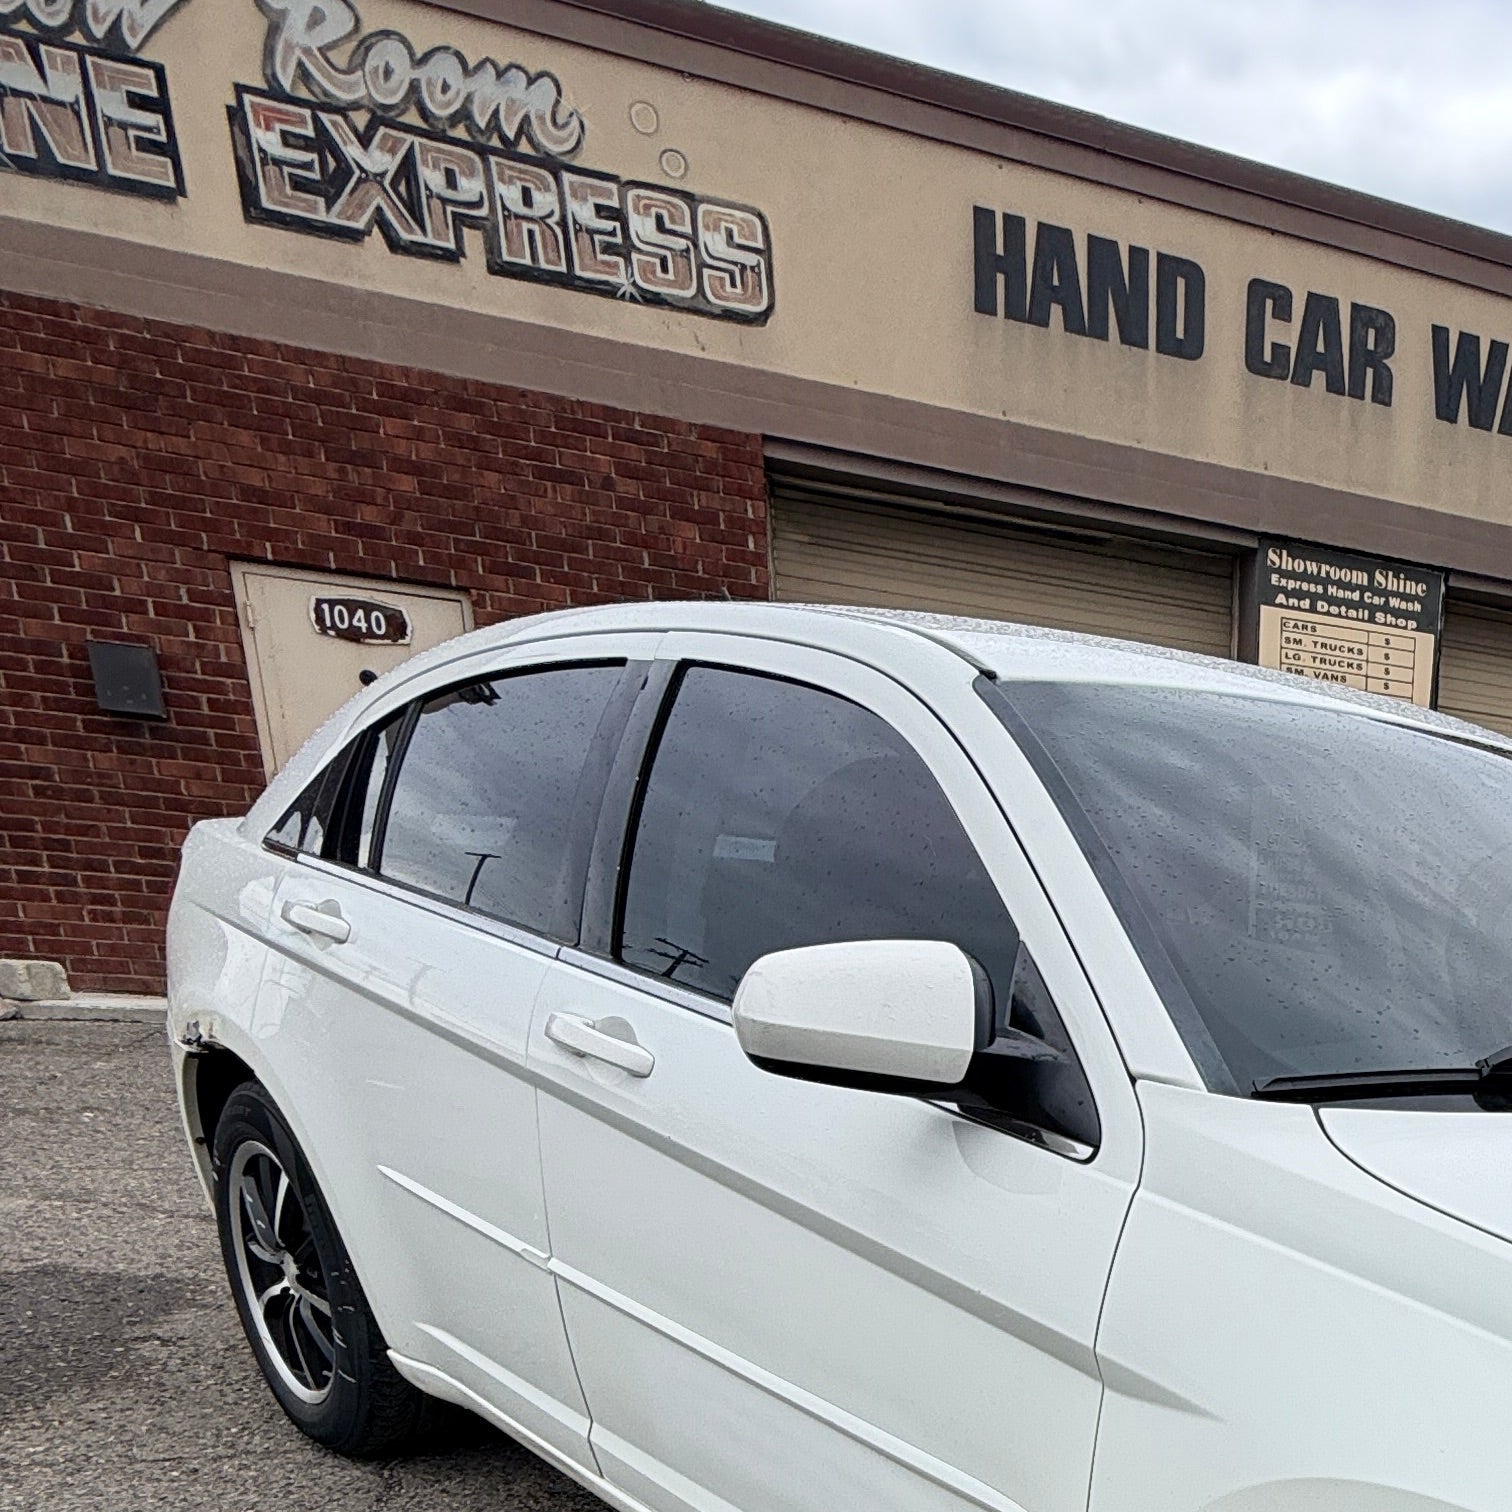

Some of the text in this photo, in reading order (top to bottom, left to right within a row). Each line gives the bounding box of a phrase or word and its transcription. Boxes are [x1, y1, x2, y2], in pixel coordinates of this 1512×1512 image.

[262, 0, 582, 157] Room
[232, 85, 772, 321] EXPRESS
[972, 205, 1206, 362] HAND
[1244, 277, 1397, 408] CAR
[1266, 547, 1428, 597] Showroom Shine
[1270, 573, 1422, 613] Express Hand Car Wash
[1274, 593, 1418, 631] And Detail Shop
[320, 602, 387, 636] 1040
[1283, 621, 1318, 633] CARS
[1310, 655, 1364, 671] TRUCKS
[1311, 640, 1364, 656] TRUCKS
[1313, 671, 1347, 684] VANS
